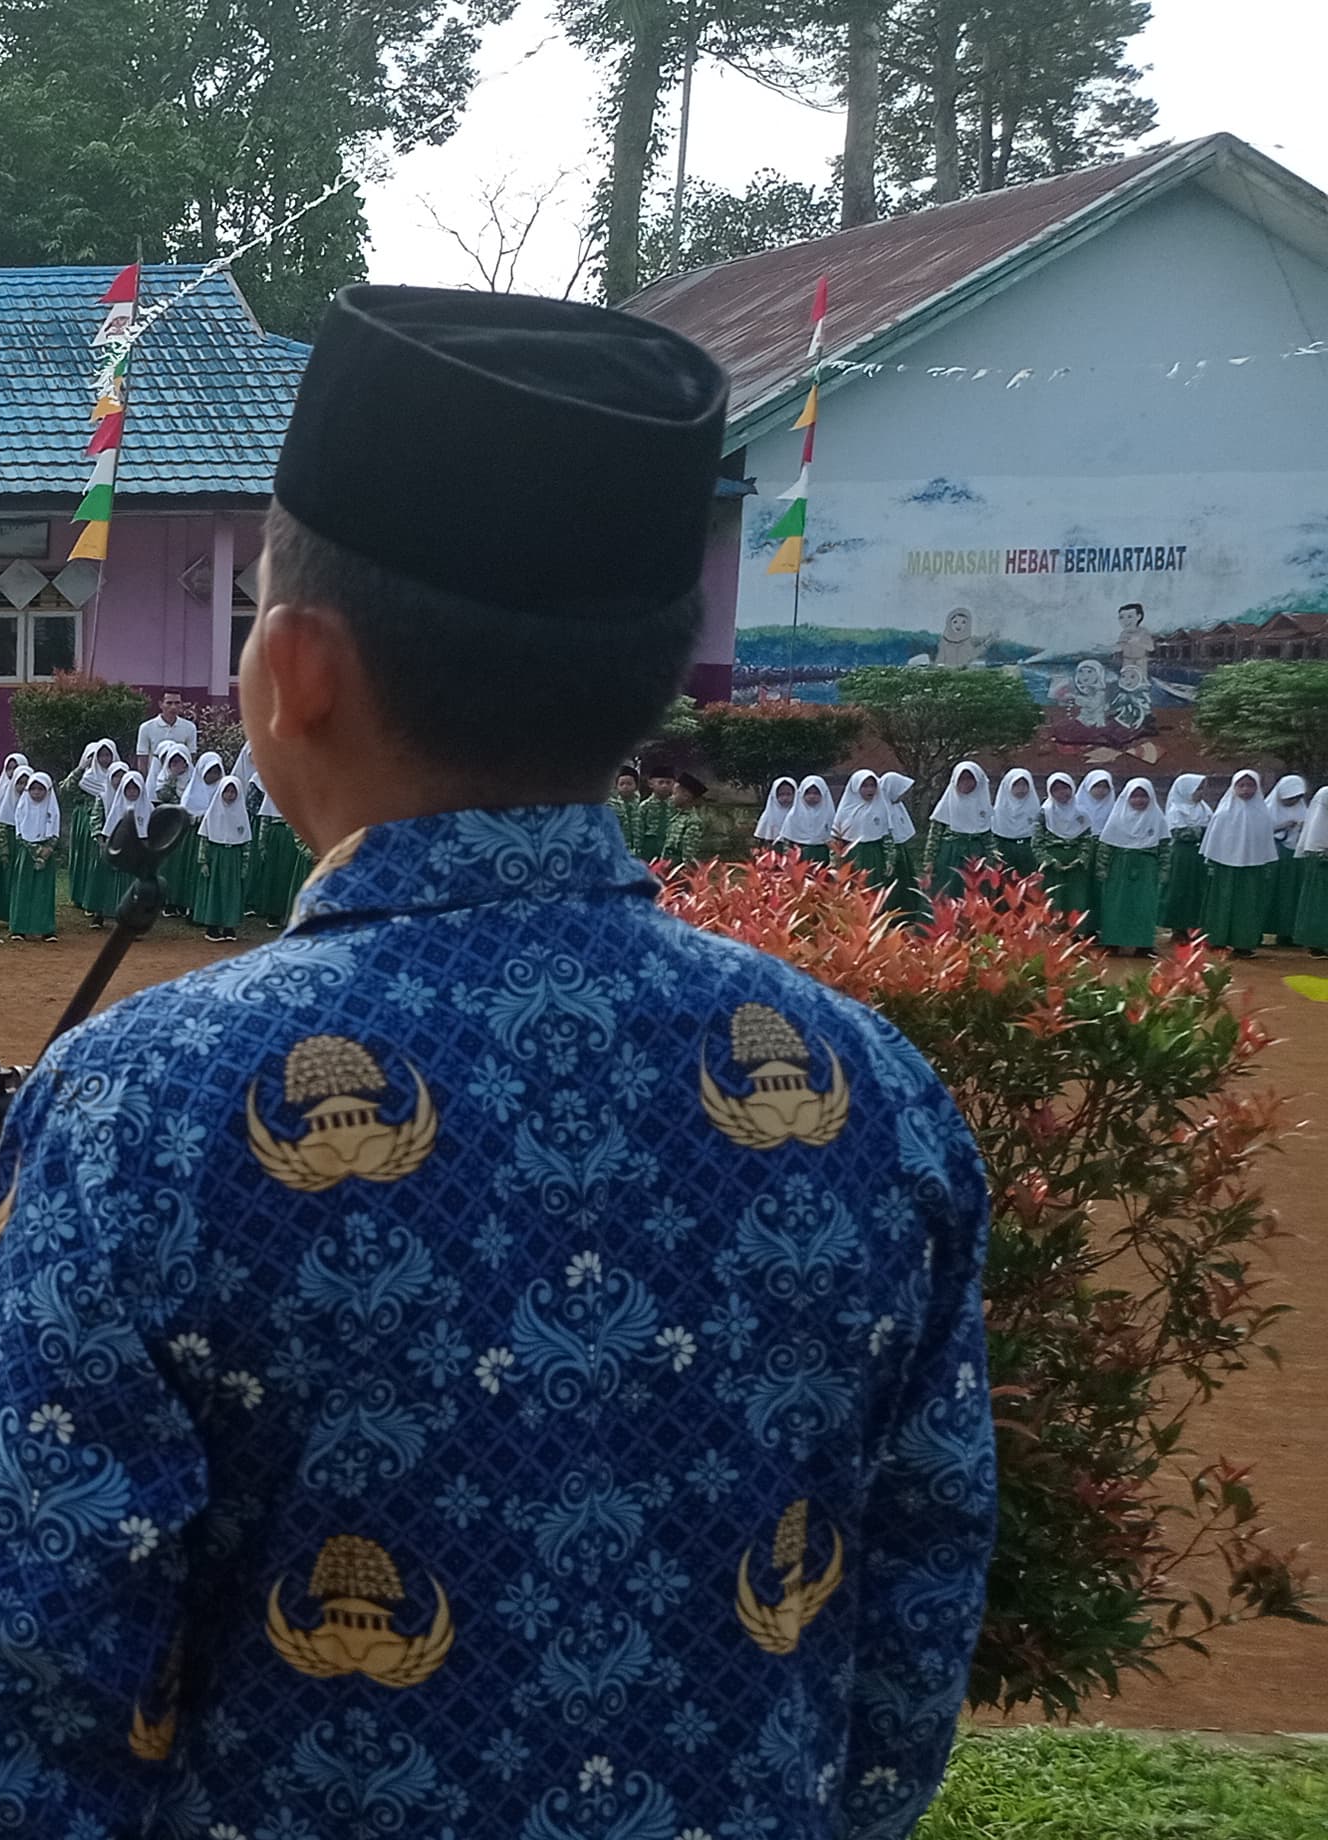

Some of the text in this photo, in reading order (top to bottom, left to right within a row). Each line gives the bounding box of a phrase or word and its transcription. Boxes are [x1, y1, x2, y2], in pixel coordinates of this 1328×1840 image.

[907, 546, 1187, 576] MADRASAH HEBAT BERMARTABAT
